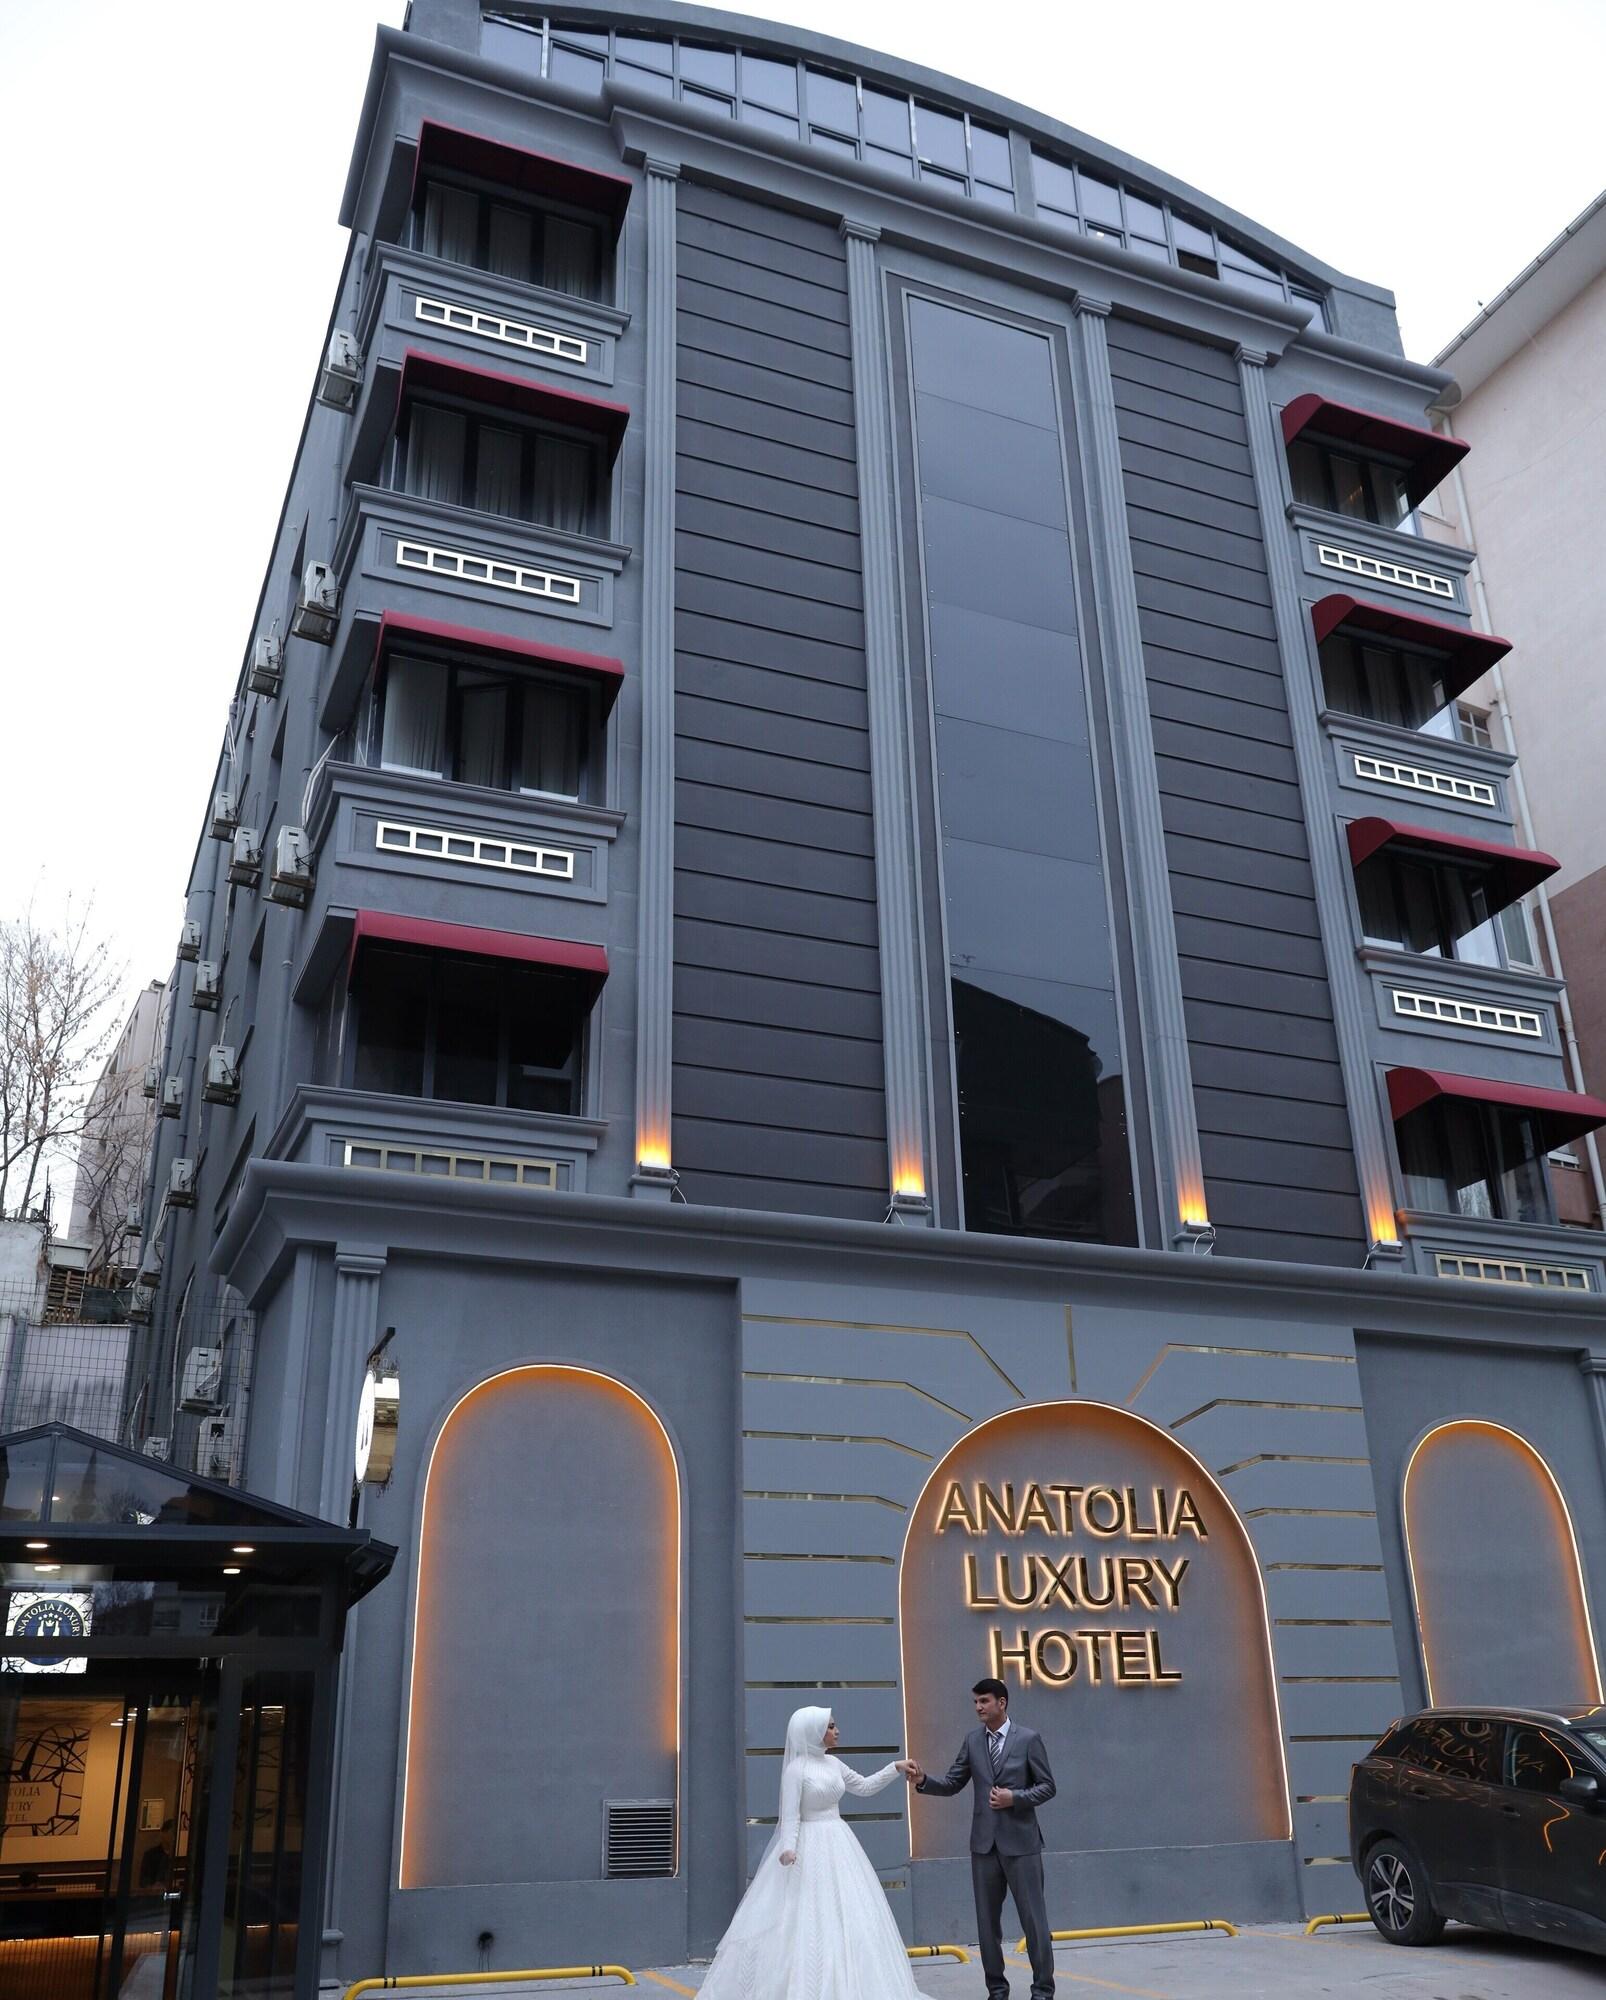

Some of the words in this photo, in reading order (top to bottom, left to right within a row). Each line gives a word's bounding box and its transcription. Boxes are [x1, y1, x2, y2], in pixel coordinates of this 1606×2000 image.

[936, 1481, 1208, 1538] ANATOLIA
[964, 1552, 1190, 1609] LUXURY
[989, 1627, 1183, 1685] HOTEL
